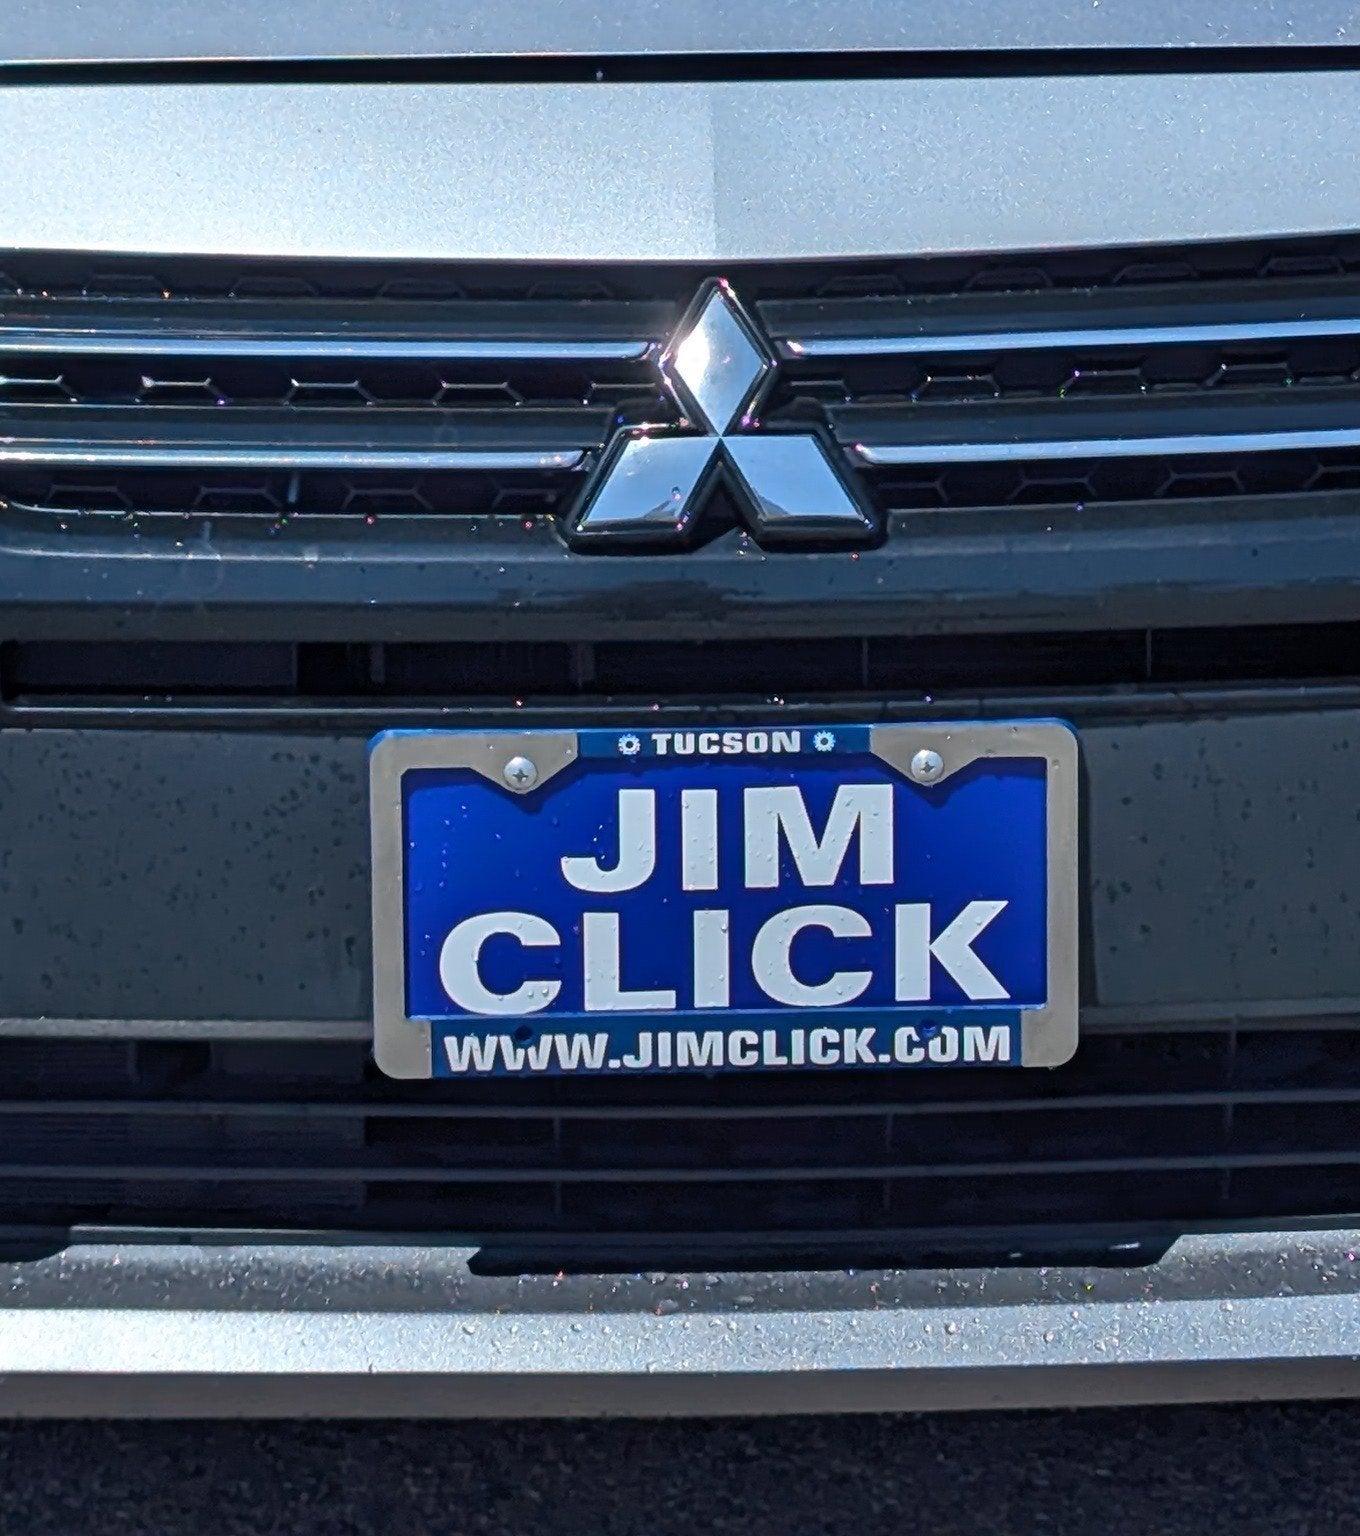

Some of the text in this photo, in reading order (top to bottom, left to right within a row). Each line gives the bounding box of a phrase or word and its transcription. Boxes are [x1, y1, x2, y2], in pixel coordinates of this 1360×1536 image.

[651, 729, 802, 757] TUCSON
[560, 783, 895, 894] JIM
[438, 899, 1013, 1016] CLICK
[443, 1024, 1013, 1073] WWW.JIMCLICK.COM
